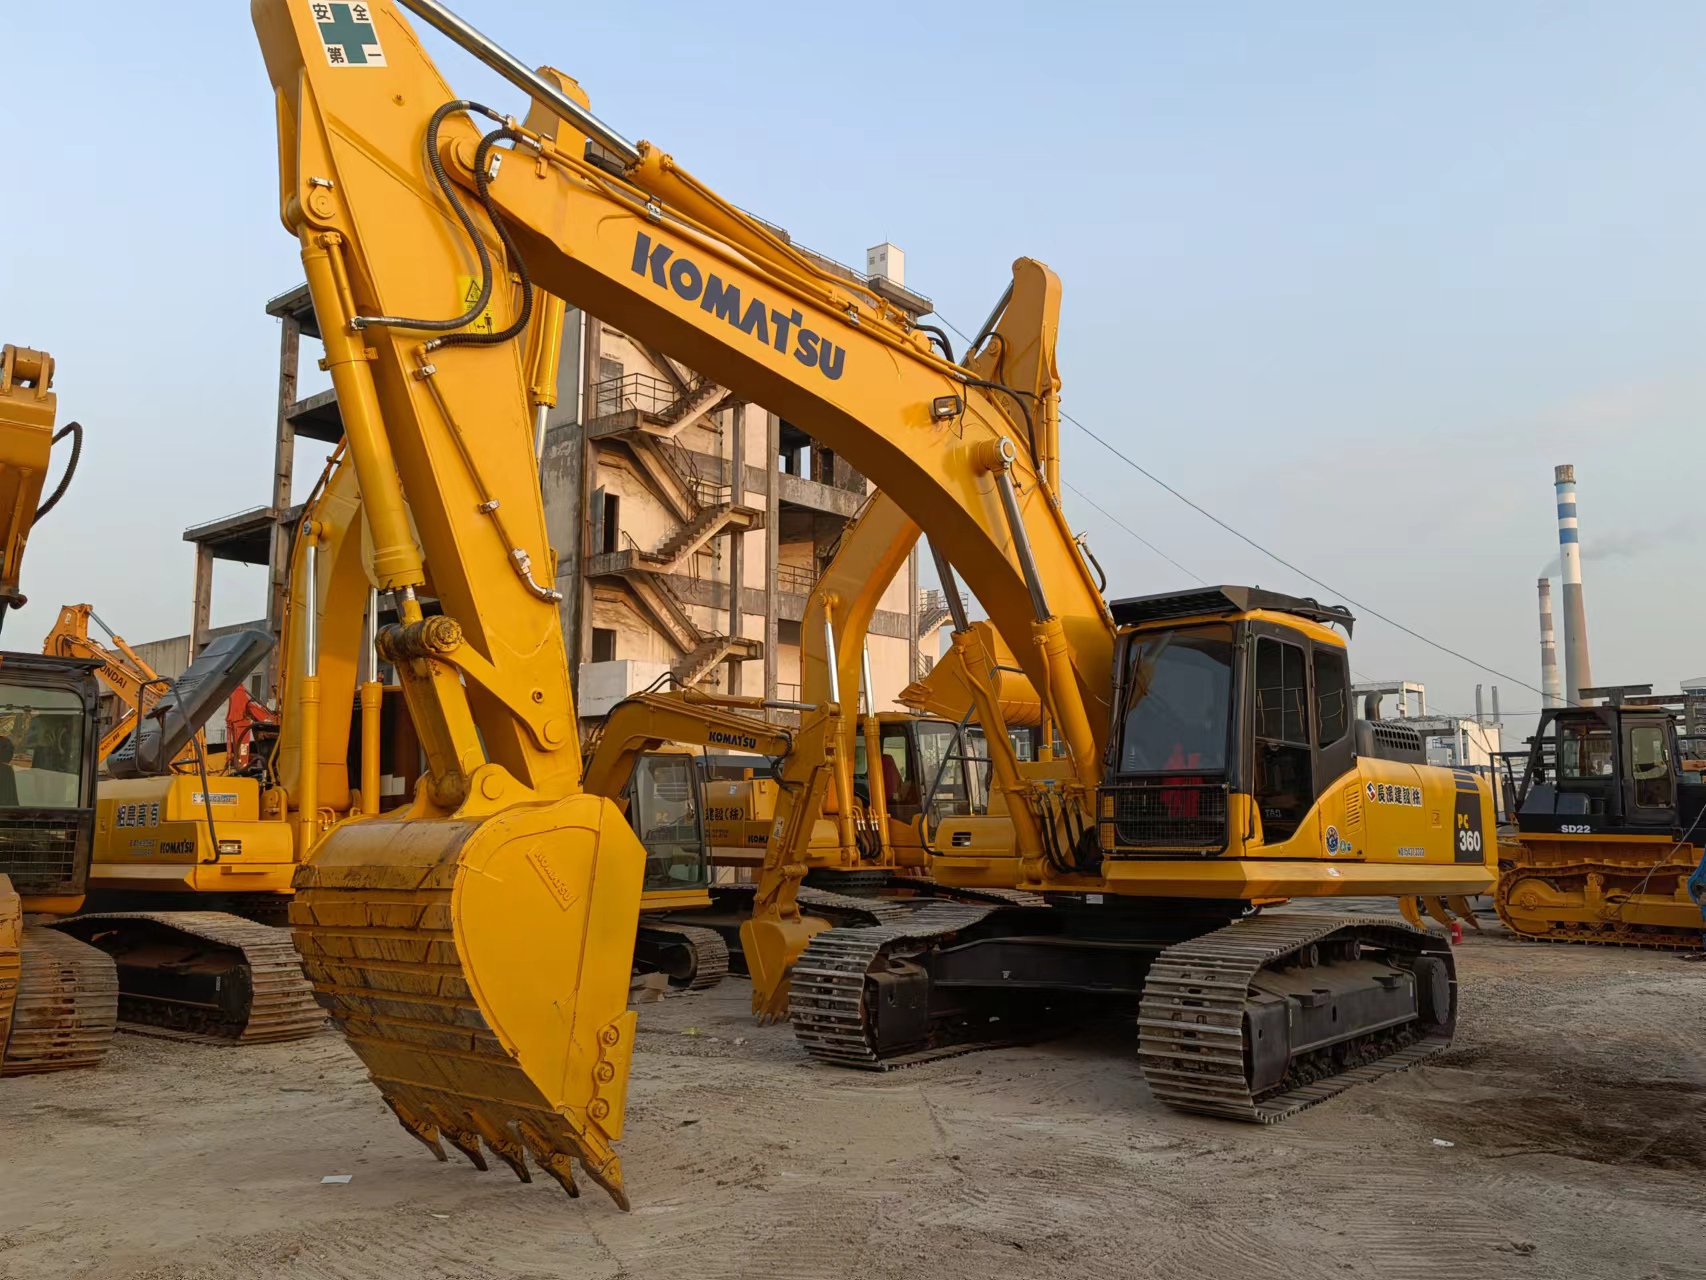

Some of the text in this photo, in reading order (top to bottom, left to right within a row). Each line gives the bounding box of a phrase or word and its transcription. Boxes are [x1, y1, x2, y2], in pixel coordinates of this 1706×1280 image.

[631, 231, 846, 381] KOMATSU
[708, 731, 757, 749] KOMATSU
[1457, 813, 1469, 829] PC
[1560, 824, 1591, 833] SD22
[160, 839, 195, 854] KOMATSU
[1459, 830, 1481, 851] 360
